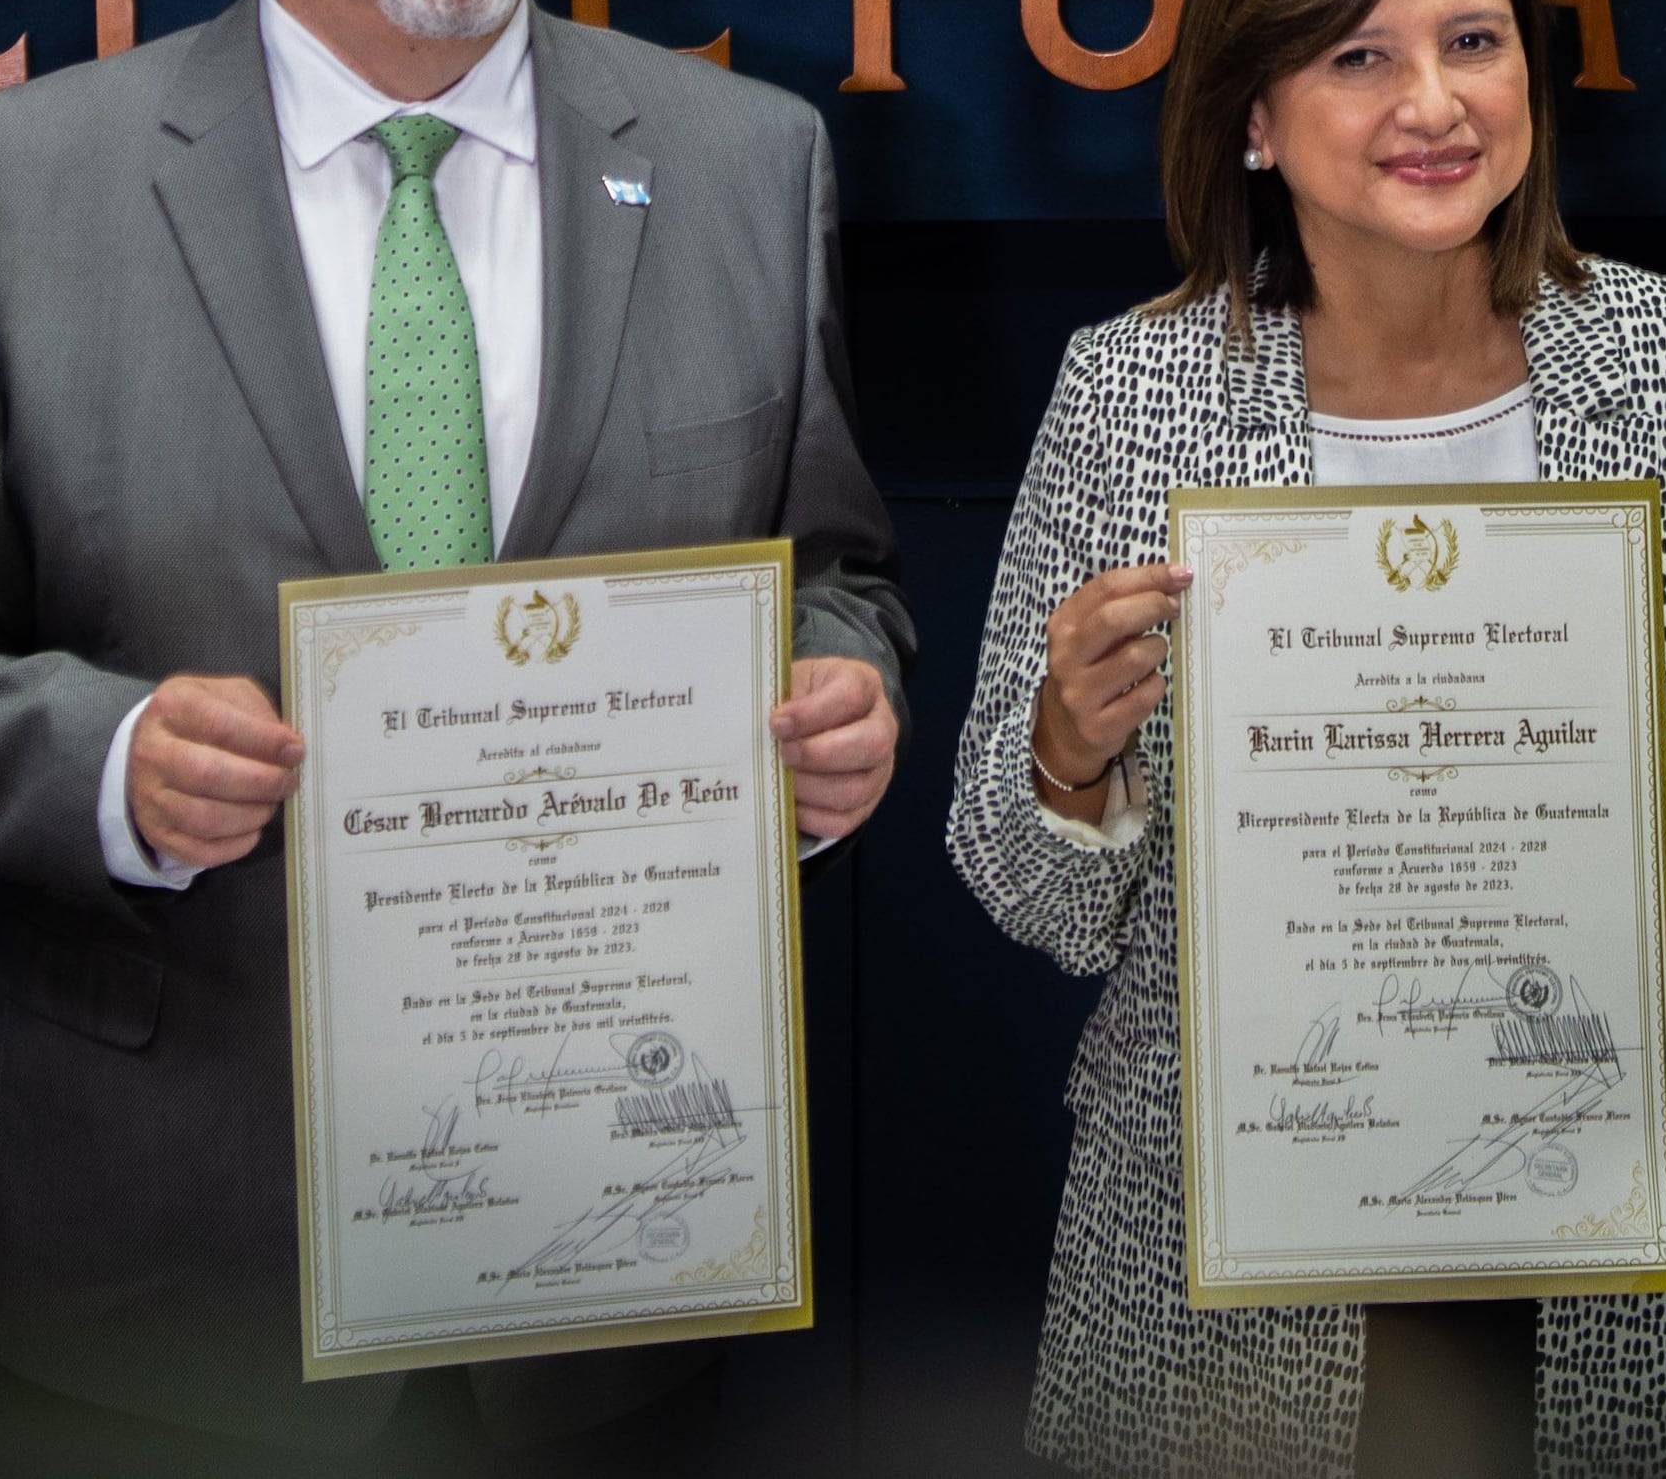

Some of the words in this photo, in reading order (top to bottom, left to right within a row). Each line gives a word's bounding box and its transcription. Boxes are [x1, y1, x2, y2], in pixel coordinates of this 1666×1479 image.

[1267, 626, 1292, 657] El
[1300, 626, 1382, 649] Tribunal
[1388, 624, 1475, 652] Supremo
[1482, 622, 1569, 651] Electoral
[1354, 672, 1401, 689] Acredita
[1405, 676, 1412, 686] a
[1416, 672, 1427, 685] la
[1432, 672, 1485, 685] ciudadana
[381, 709, 407, 738] El
[416, 703, 500, 729] Tribunal
[507, 699, 597, 724] Supremo
[605, 686, 693, 716] Electoral
[1246, 724, 1314, 762] Karin
[1323, 722, 1410, 760] Larissa
[1418, 720, 1506, 757] Herrera
[1513, 718, 1598, 755] Aguilar
[477, 747, 525, 762] Acredita
[530, 743, 540, 757] al
[545, 741, 601, 756] ciudadano
[1409, 787, 1438, 797] como
[343, 808, 410, 836] César
[418, 798, 529, 834] Bernardo
[536, 786, 627, 824] Arévalo
[636, 781, 671, 815] De
[679, 777, 739, 811] León
[1237, 811, 1340, 833] Vicepresidente
[1344, 807, 1390, 829] Electa
[1397, 809, 1413, 824] de
[1418, 807, 1431, 824] la
[1437, 805, 1506, 828] República
[1513, 805, 1529, 821] de
[1535, 802, 1610, 821] Guatemala
[528, 855, 557, 867] como
[364, 887, 442, 913] Presidente
[447, 882, 495, 901] Electo
[502, 880, 518, 895] de
[524, 877, 537, 893] la
[544, 872, 615, 894] República
[622, 870, 638, 884] de
[644, 861, 721, 882] Guatemala
[1338, 883, 1351, 896] de
[1355, 881, 1383, 897] fecha
[1406, 881, 1420, 894] de
[1423, 879, 1461, 897] agosto
[1465, 879, 1478, 892] de
[1285, 920, 1316, 937] Dado
[1320, 923, 1333, 934] en
[1337, 919, 1348, 933] la
[1351, 917, 1382, 934] Sede
[1386, 917, 1402, 932] del
[1406, 916, 1455, 932] Tribunal
[1457, 915, 1510, 932] Supremo
[1351, 941, 1364, 952] en
[1368, 937, 1380, 951] la
[1384, 937, 1419, 951] ciudad
[1424, 936, 1437, 950] de
[1305, 958, 1315, 972] el
[1353, 957, 1366, 970] de
[1370, 955, 1429, 973] septiembre
[1433, 954, 1446, 968] de
[1450, 954, 1474, 968] dos
[1473, 952, 1494, 968] mil
[401, 996, 433, 1012] Dado
[438, 997, 451, 1007] en
[455, 993, 467, 1005] la
[471, 989, 500, 1005] Sede
[505, 987, 522, 1001] del
[526, 982, 575, 999] Tribunal
[579, 980, 632, 995] Supremo
[470, 1013, 483, 1023] en
[487, 1008, 499, 1021] la
[503, 1005, 539, 1020] ciudad
[544, 1004, 558, 1016] de
[422, 1032, 432, 1046] el
[471, 1029, 485, 1041] de
[553, 1021, 567, 1033] de
[571, 1020, 591, 1032] dos
[596, 1015, 614, 1029] mil
